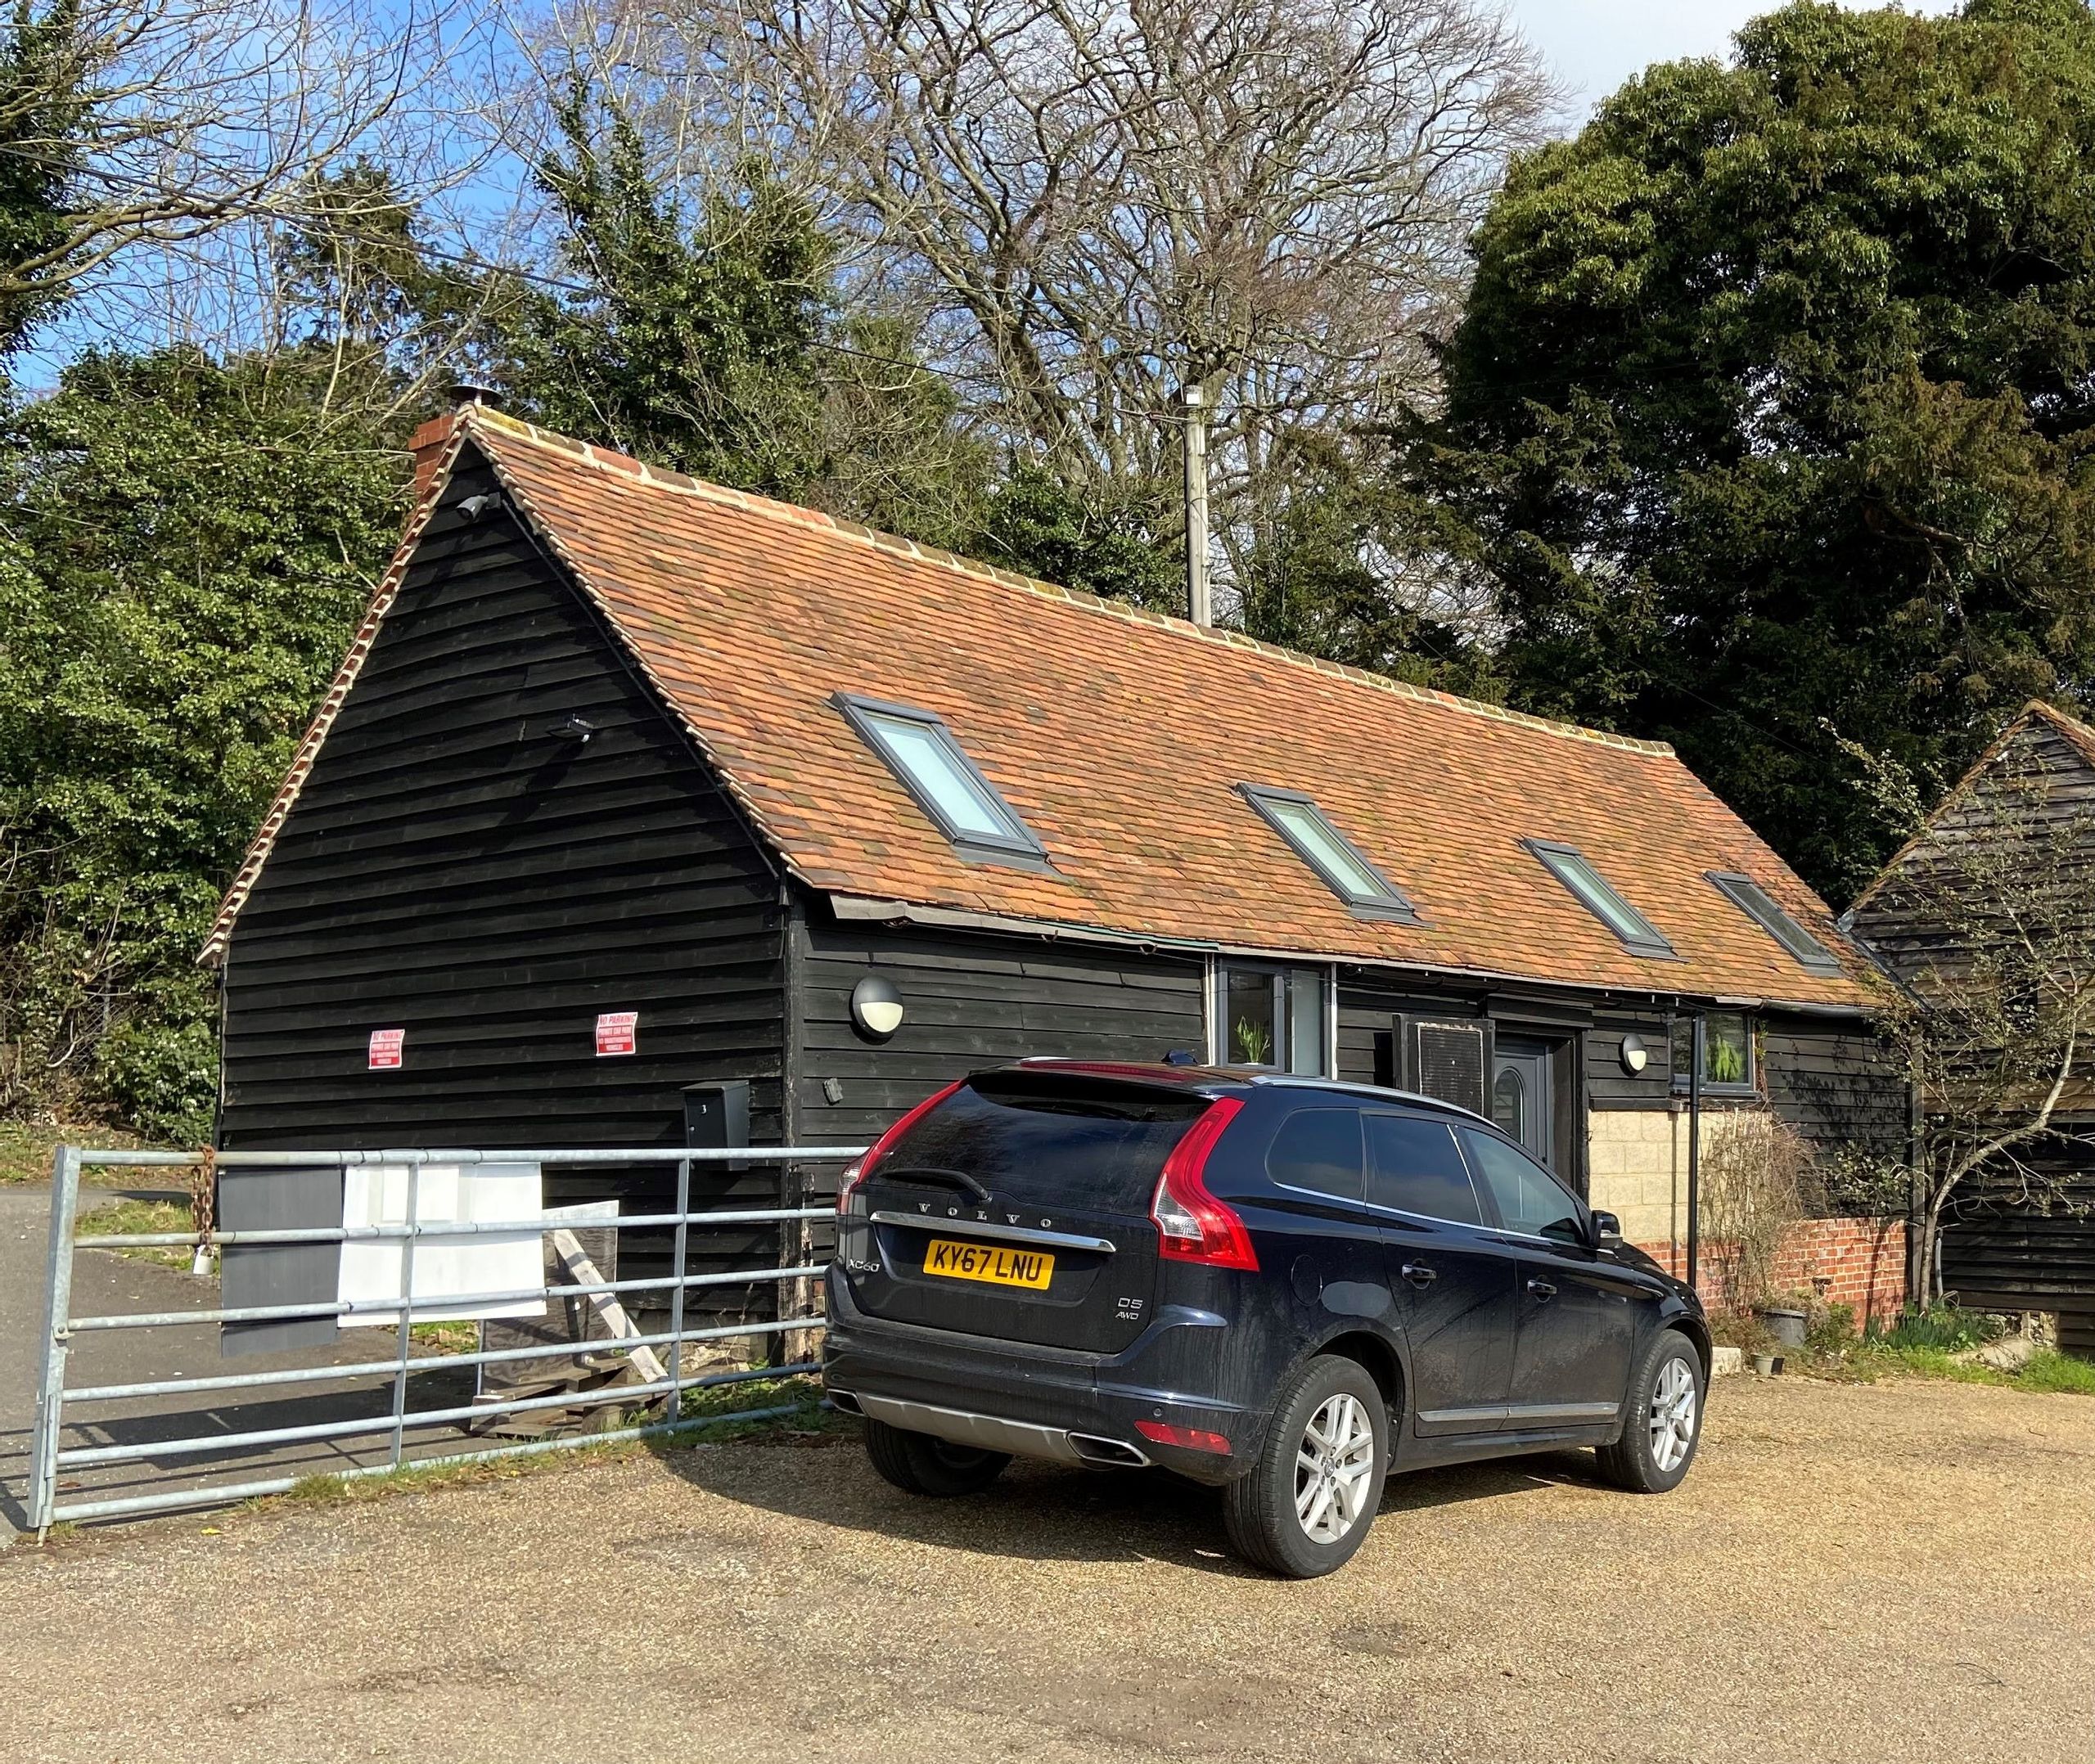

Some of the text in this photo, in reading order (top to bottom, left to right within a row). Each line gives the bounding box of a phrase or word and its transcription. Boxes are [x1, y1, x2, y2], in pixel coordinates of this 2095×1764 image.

[701, 1104, 707, 1114] 3
[918, 1203, 1052, 1227] VOLVO
[846, 1258, 880, 1271] XC60
[933, 1244, 1043, 1282] KY67 LNU
[1115, 1311, 1139, 1321] AWD
